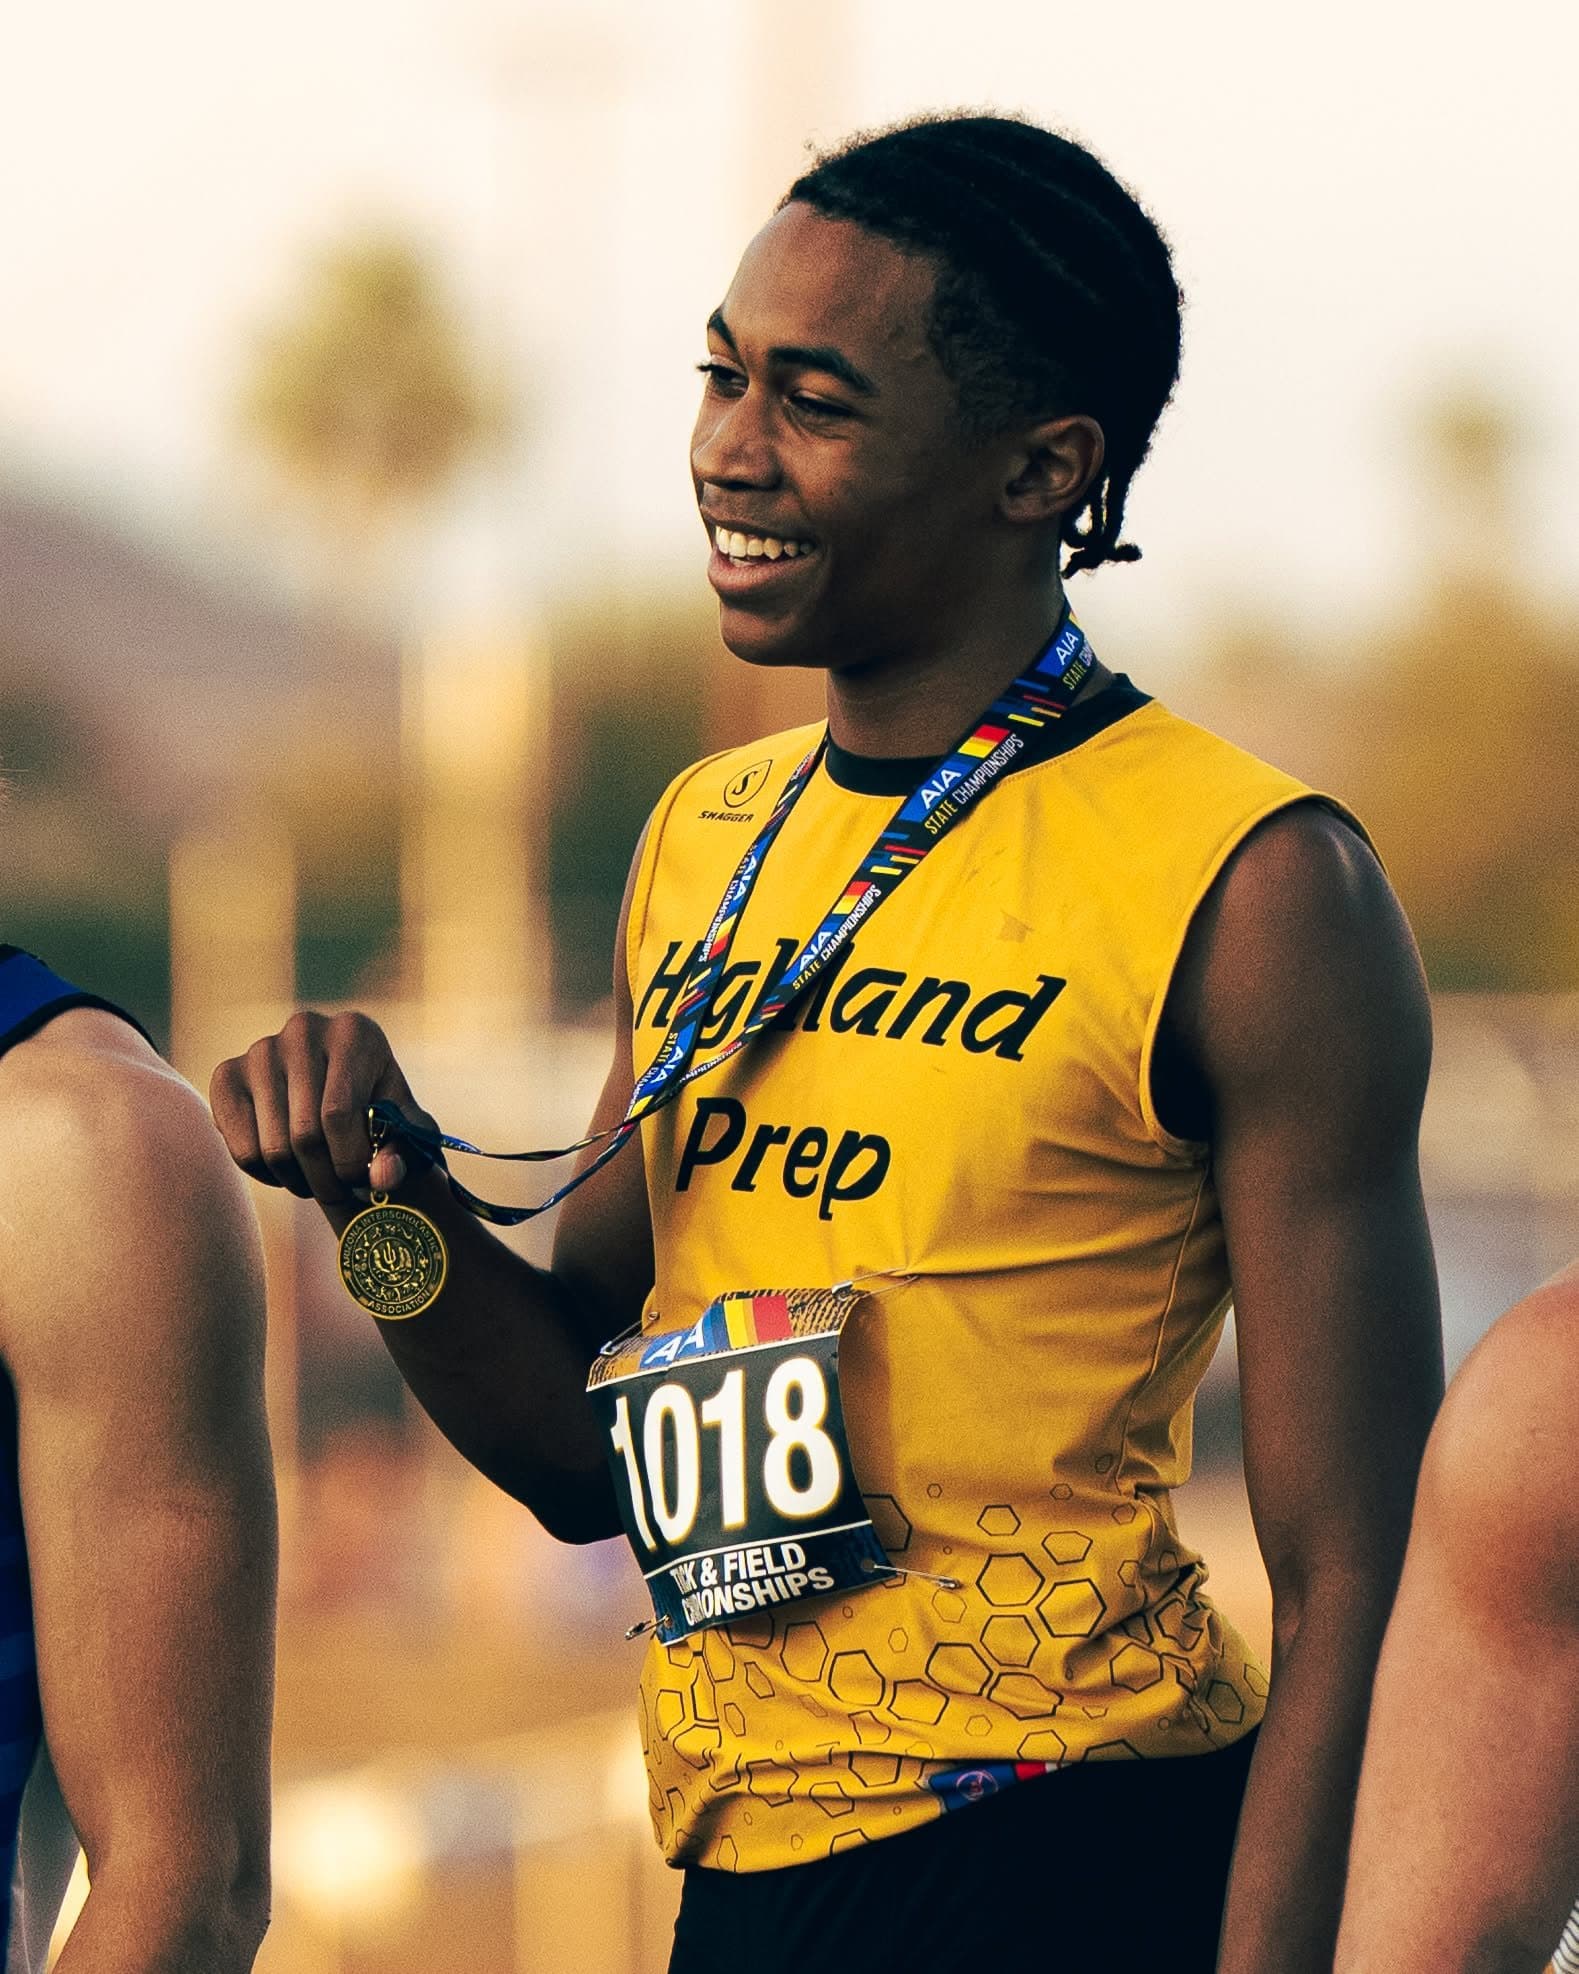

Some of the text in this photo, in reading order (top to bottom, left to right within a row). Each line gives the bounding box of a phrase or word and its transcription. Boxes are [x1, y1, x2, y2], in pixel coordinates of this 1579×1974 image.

[1055, 631, 1079, 666] AIA
[1062, 660, 1087, 691] STATE
[920, 768, 962, 810] AIA
[924, 733, 1024, 835] STATE CHAMPIONSHIPS
[697, 810, 755, 823] SWAGGER
[733, 855, 757, 900] AIA
[792, 884, 882, 991] STATE CHAMPIONSHIPS
[800, 931, 834, 972] AIA
[634, 937, 1067, 1062] Hghland
[651, 1046, 684, 1084] AIA
[675, 1097, 891, 1221] Prep
[367, 1289, 431, 1314] ASSOCIATION
[609, 1356, 841, 1552] 1018
[700, 1557, 718, 1587] &
[723, 1542, 806, 1583] FIELD
